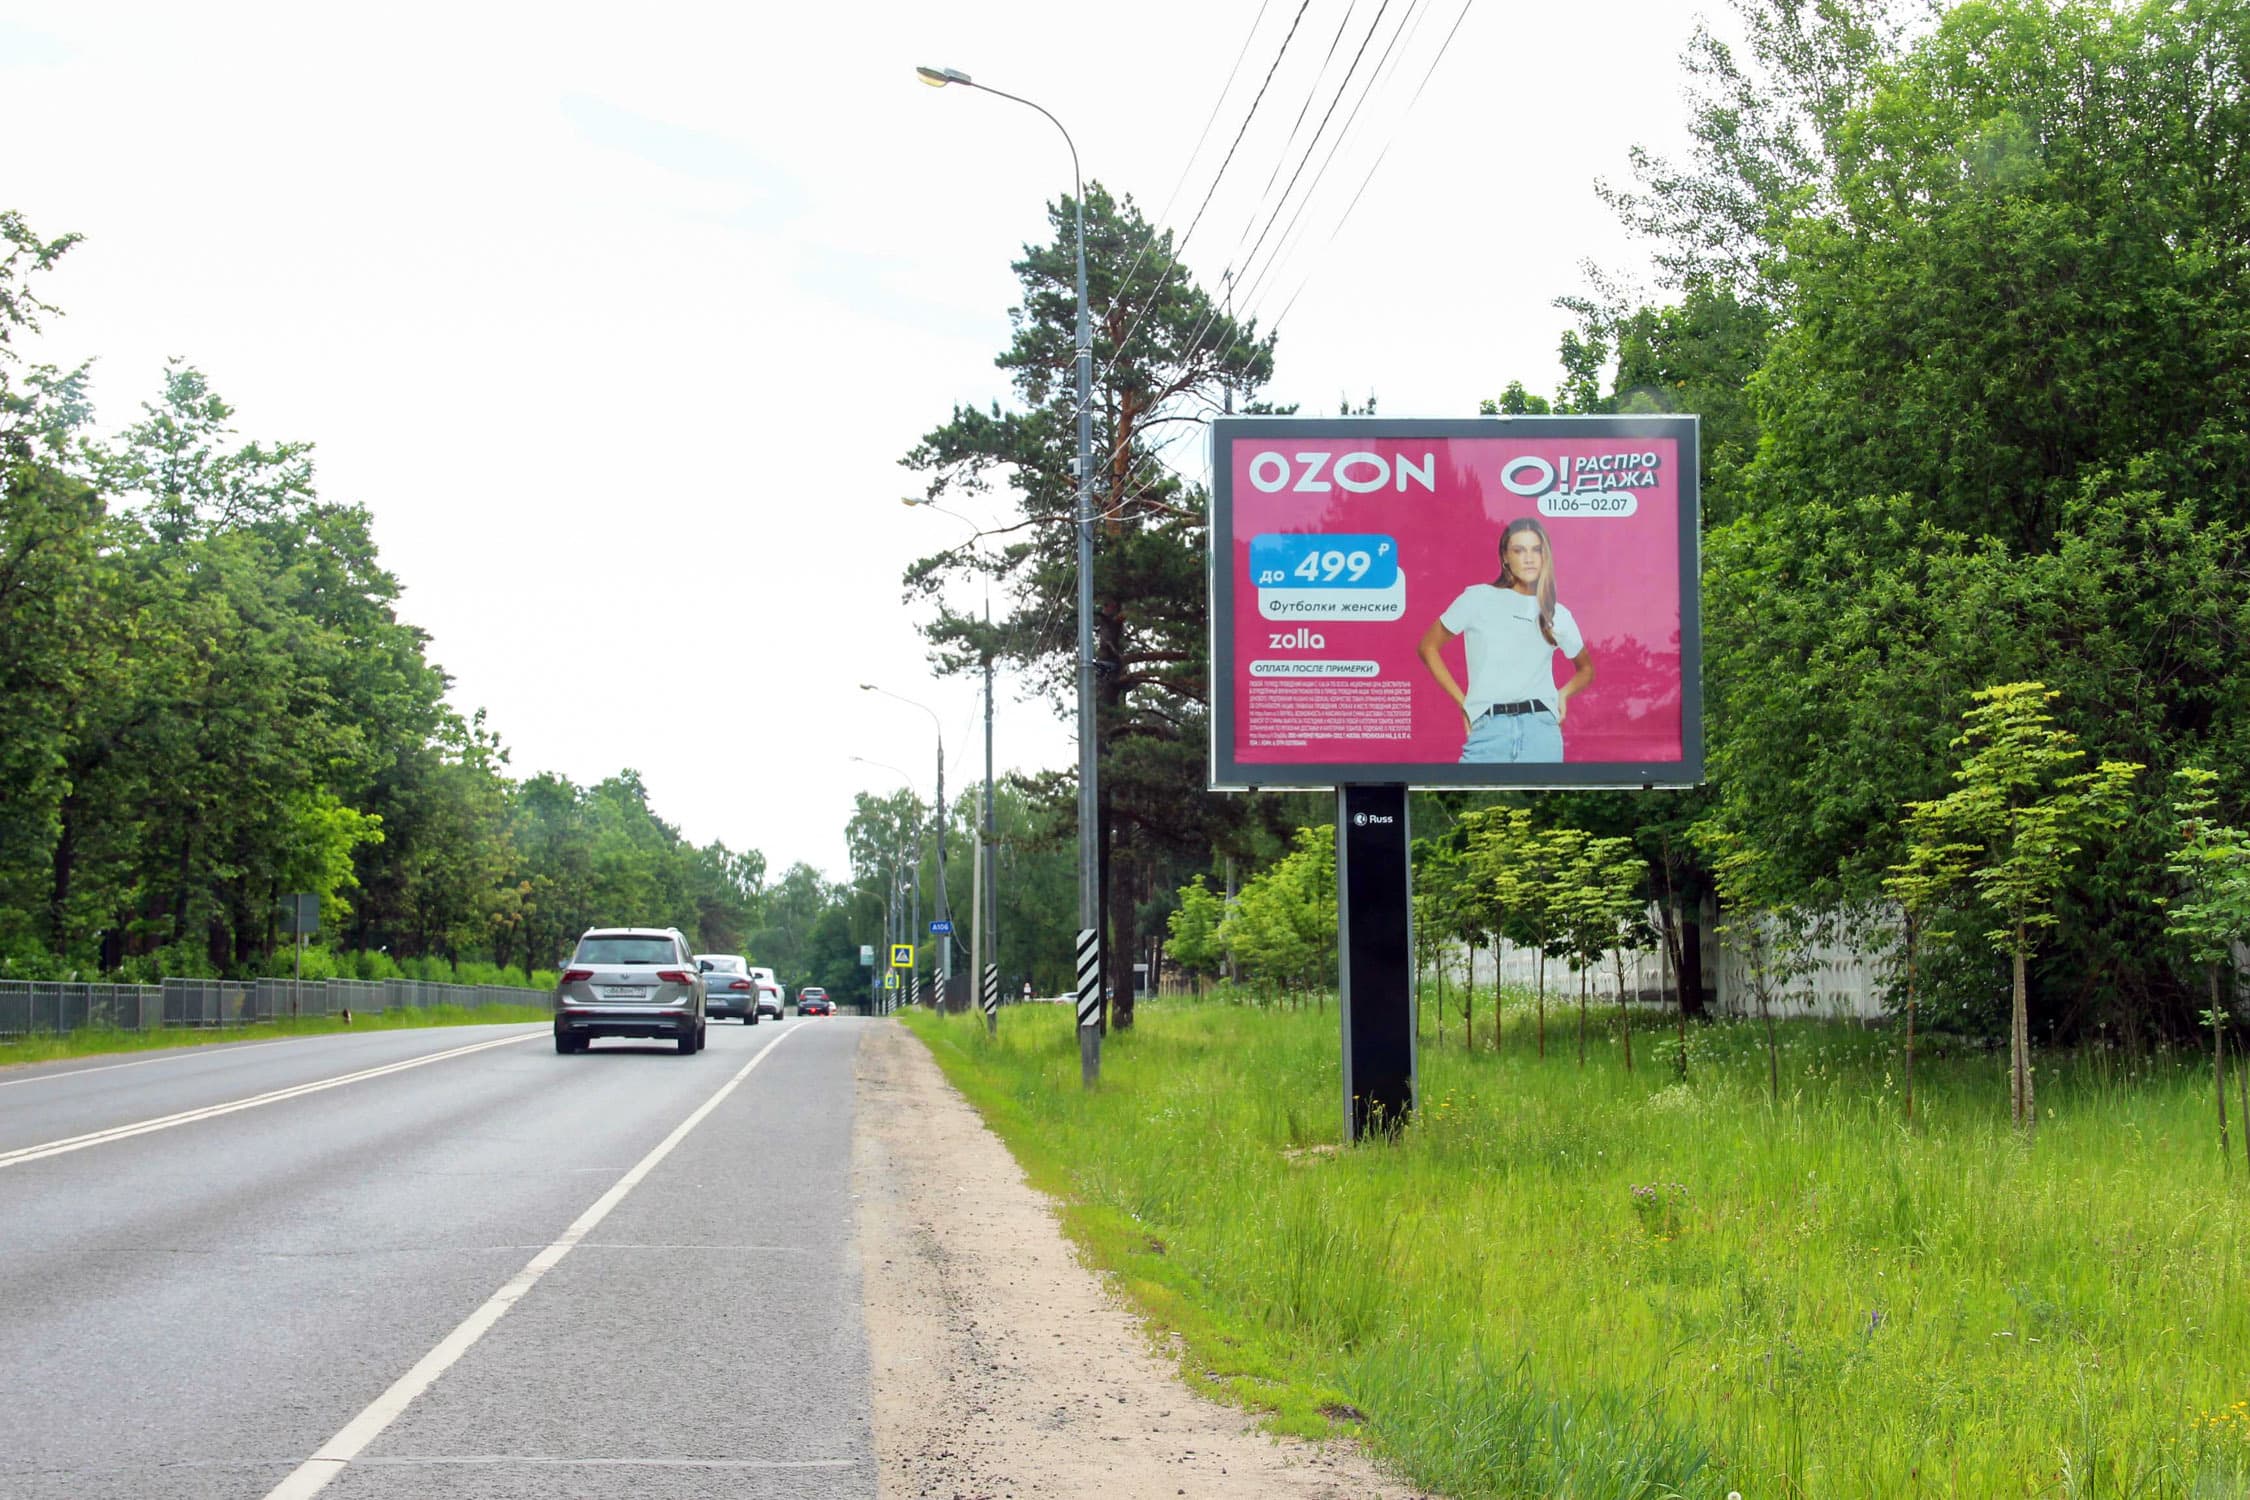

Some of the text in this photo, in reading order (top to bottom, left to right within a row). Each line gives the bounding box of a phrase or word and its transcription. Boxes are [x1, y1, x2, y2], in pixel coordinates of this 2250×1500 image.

[1249, 451, 1435, 493] OZON
[1575, 452, 1659, 472] РАСПРО
[1573, 471, 1657, 494] ДАЖА
[1259, 570, 1286, 583] до
[1294, 551, 1371, 582] 499
[1269, 600, 1398, 614] Футболки женские
[1269, 628, 1325, 649] zolla
[1255, 664, 1373, 673] ОПЛАТА ПОСЛЕ ПРИМЕРКИ
[1369, 814, 1393, 824] Russ
